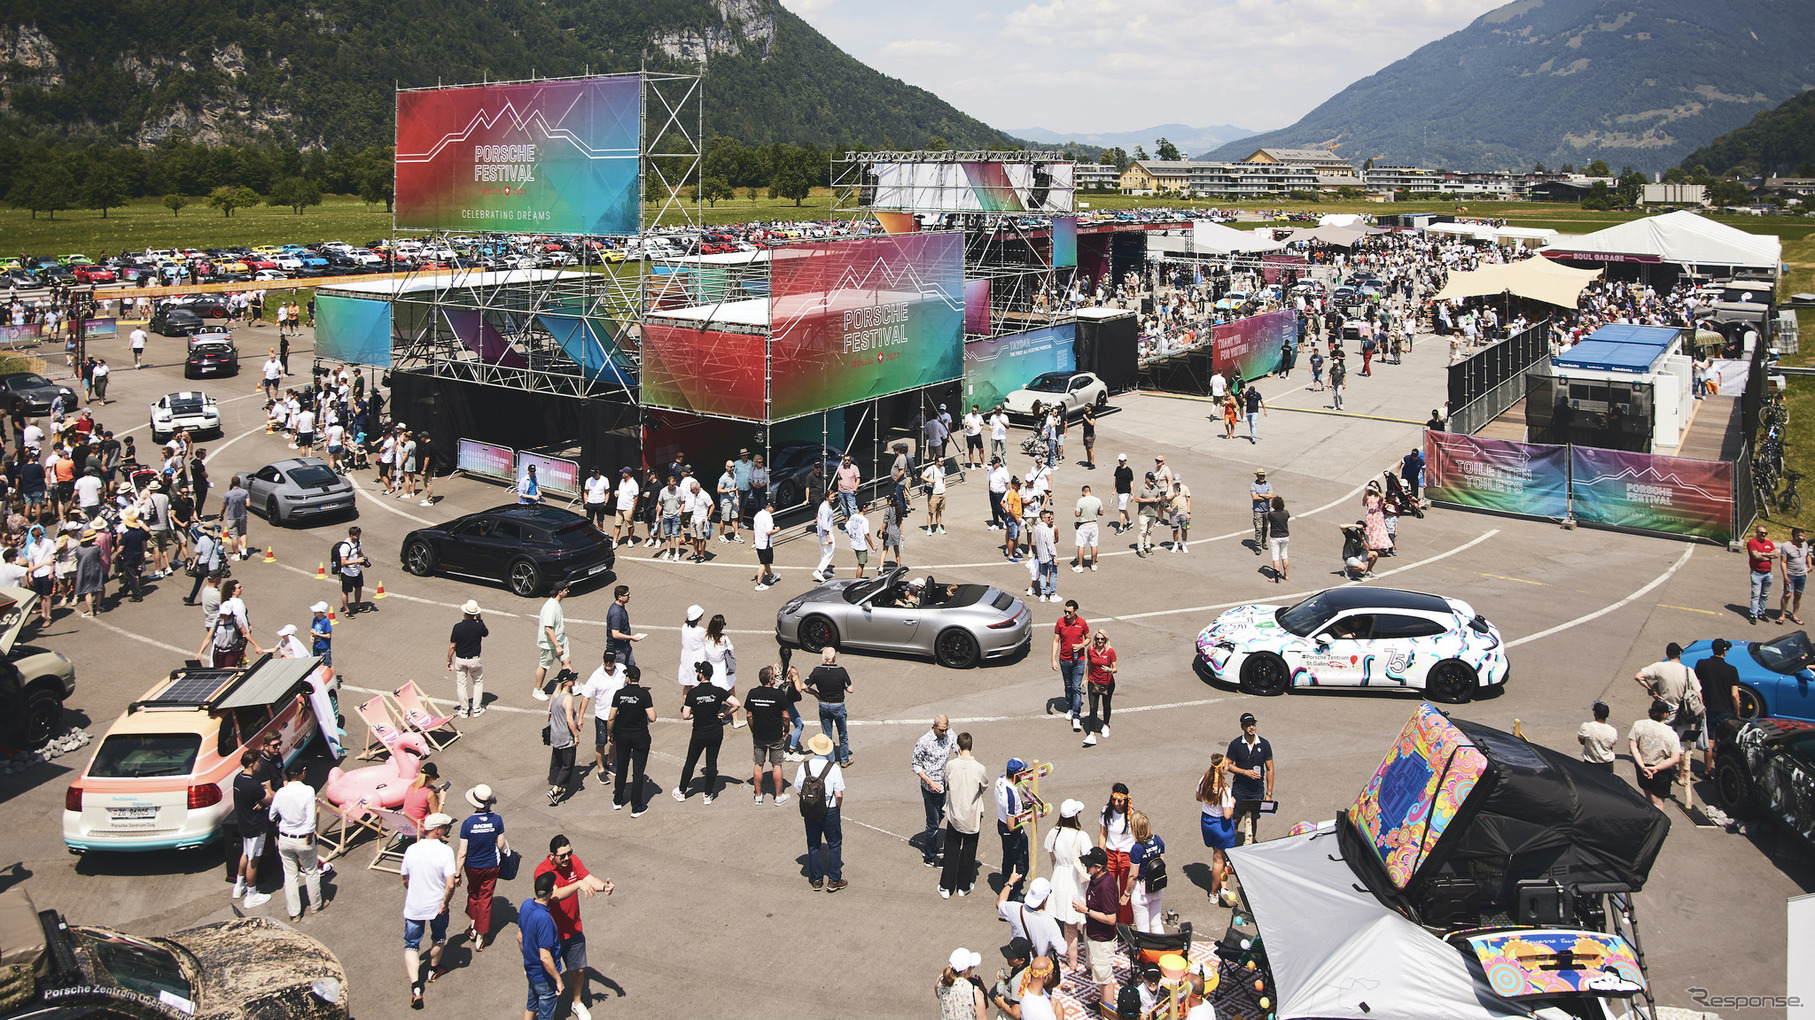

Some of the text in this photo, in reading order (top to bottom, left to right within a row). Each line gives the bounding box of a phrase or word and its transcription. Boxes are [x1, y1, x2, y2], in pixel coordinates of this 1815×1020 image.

[474, 144, 535, 163] PORSCHE
[474, 164, 535, 182] FESTIVAL
[461, 209, 551, 220] CELEBRATING DREAMS
[1573, 252, 1593, 260] SOUL
[843, 301, 909, 331] PORSCHE
[843, 324, 908, 355] FESTIVAL
[886, 352, 901, 361] 2023
[1455, 459, 1533, 481] TOILETTEN
[1464, 474, 1523, 494] TOILETS
[1626, 482, 1673, 497] PORSCHE
[1626, 491, 1673, 506] FESTIVAL
[1383, 647, 1407, 674] 75
[44, 984, 91, 999] Porsche
[92, 984, 137, 1000] Zentrum
